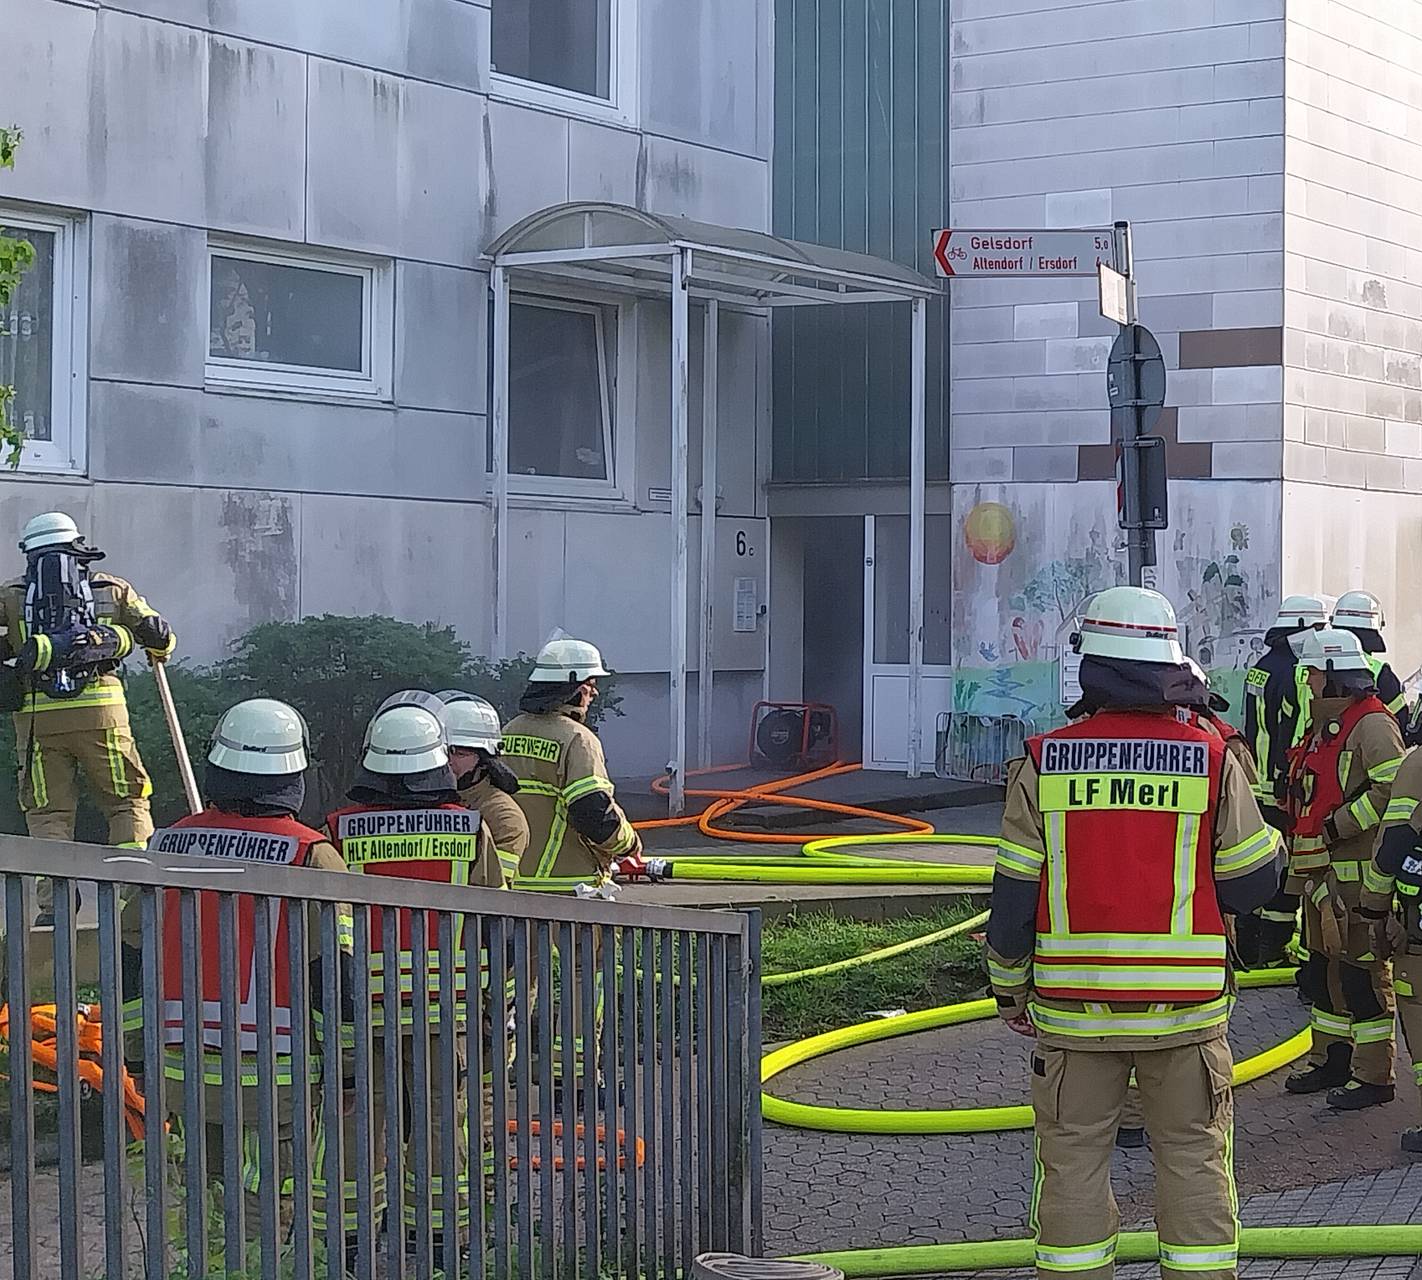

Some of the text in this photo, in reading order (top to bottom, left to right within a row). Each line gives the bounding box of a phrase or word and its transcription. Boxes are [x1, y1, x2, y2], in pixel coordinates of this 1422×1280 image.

[971, 236, 1109, 251] Gelsdorf 5,0
[972, 257, 1024, 271] Altendorf
[1029, 258, 1034, 270] /
[1038, 257, 1078, 271] Ersdorf
[1045, 740, 1205, 774] GRUPPENFÜHRER
[1068, 778, 1180, 808] LF Merl
[347, 810, 471, 837] GRUPPENFÜHRER
[347, 840, 368, 863] HLF
[370, 838, 423, 860] Altendorf
[433, 837, 472, 859] Ersdorf
